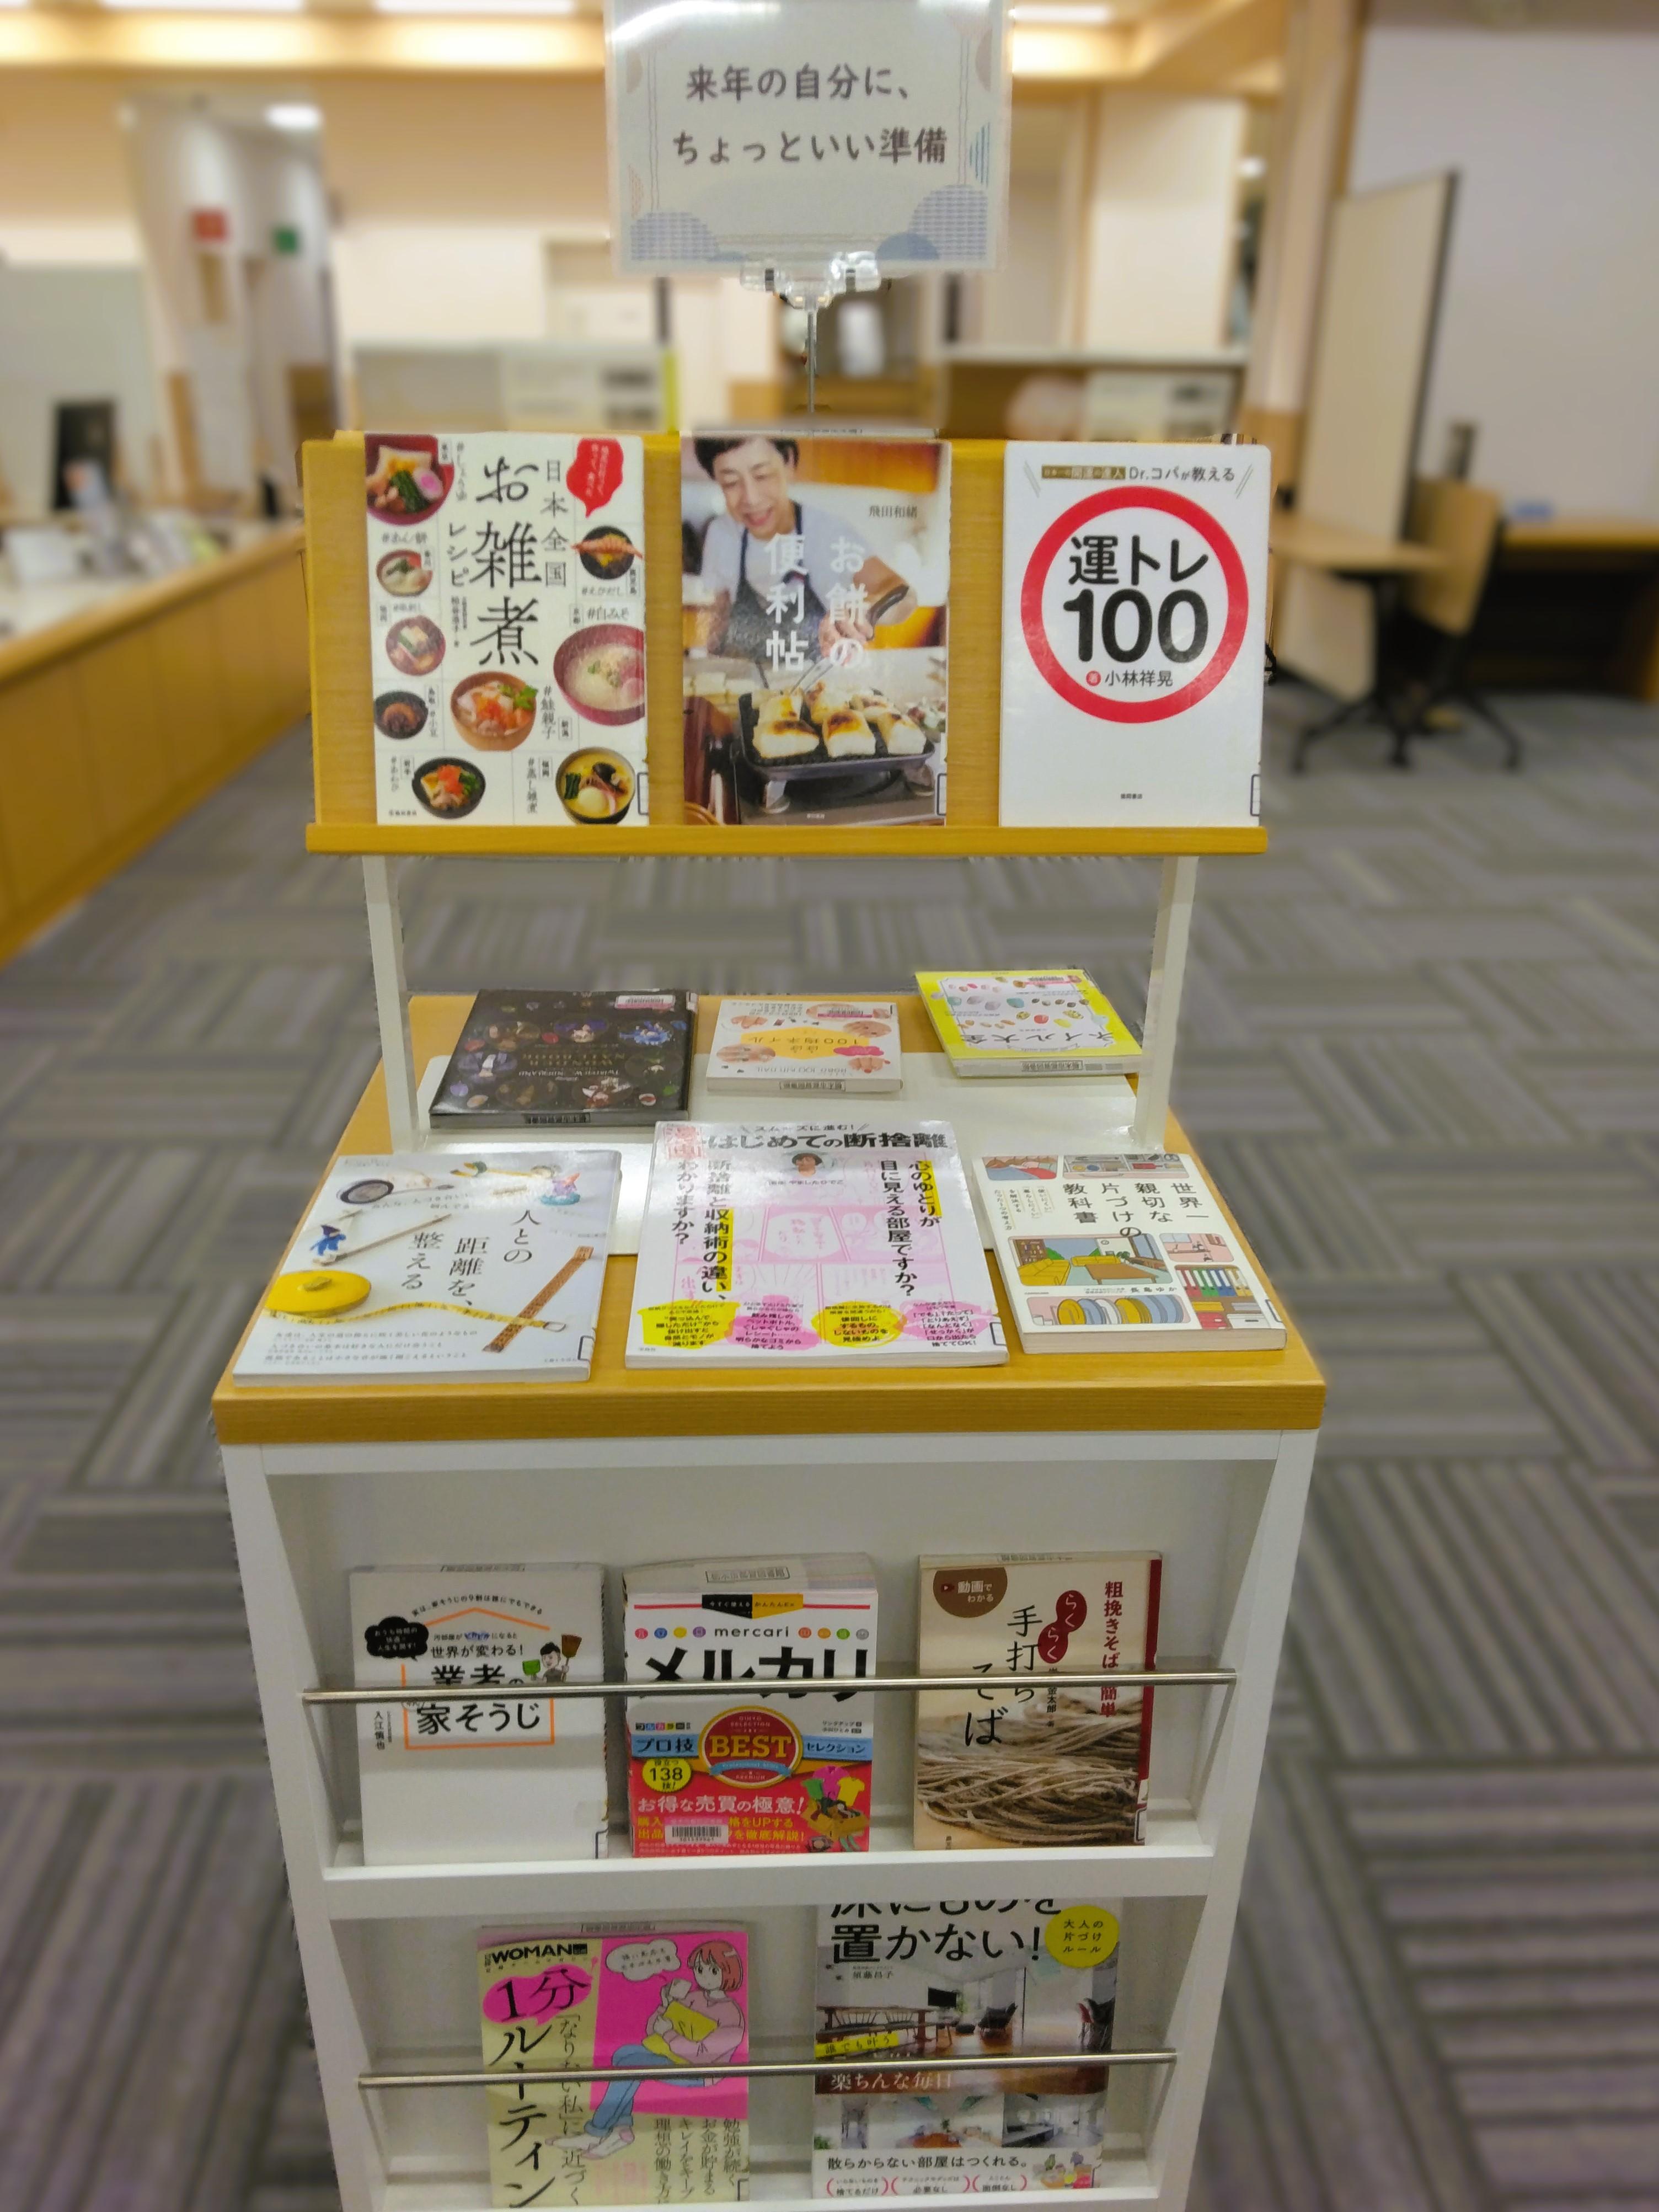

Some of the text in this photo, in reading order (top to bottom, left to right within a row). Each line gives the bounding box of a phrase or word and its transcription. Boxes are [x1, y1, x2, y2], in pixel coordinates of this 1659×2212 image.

[686, 62, 908, 102] 来年の自分に、
[672, 126, 948, 165] ちょっといい準備
[539, 460, 569, 587] 日本全国
[869, 505, 918, 519] 飛田和緒
[447, 522, 469, 587] レシピ
[469, 455, 543, 665] お雑煮
[1068, 534, 1209, 586] 運トレ
[764, 533, 809, 671] 便利帖
[827, 536, 870, 667] お餅の
[1063, 588, 1209, 663] 100
[1105, 670, 1174, 687] 小林祥晃
[708, 1132, 948, 1149] はじめての断捨離
[672, 1160, 698, 1245] わかりますか?
[909, 1160, 941, 1227] 心のゆとりが
[1062, 1183, 1098, 1223] 教科書
[1101, 1182, 1142, 1237] 片づけの
[1134, 1182, 1174, 1223] 親切な
[1170, 1182, 1210, 1219] 世界一
[503, 1209, 541, 1264] 人との
[700, 1160, 731, 1300] 断捨離と収納術の違い、
[880, 1160, 918, 1296] 目に見える部屋ですか?
[402, 1232, 445, 1290] 整える
[447, 1236, 490, 1307] 距離を、
[957, 1579, 992, 1594] 動画で
[967, 1594, 994, 1603] わかる
[430, 1644, 524, 1659] 世界が変わる!
[714, 1625, 790, 1638] mercari
[430, 1664, 525, 1686] 業者
[645, 1645, 869, 1703] メルカリ
[417, 1703, 540, 1735] 家そうじ
[965, 1663, 1009, 1746] そば
[635, 1735, 866, 1758] プロ技 BEST セレクション
[649, 1766, 683, 1782] 138
[662, 1781, 676, 1790] 技!
[637, 1795, 805, 1814] お得な売買の極意!
[637, 1816, 662, 1826] 購入
[637, 1829, 662, 1840] 出品
[831, 1923, 1041, 1963] 置かない!
[1063, 1919, 1104, 1929] 大人の
[1063, 1932, 1102, 1942] 片づけ
[491, 1943, 574, 1963] WOMAN
[497, 1968, 592, 2023] 1分
[831, 2072, 952, 2091] 楽ちんな毎日
[488, 2025, 556, 2209] ルーティン
[827, 2155, 1028, 2170] 散らからない部屋はつくれる。
